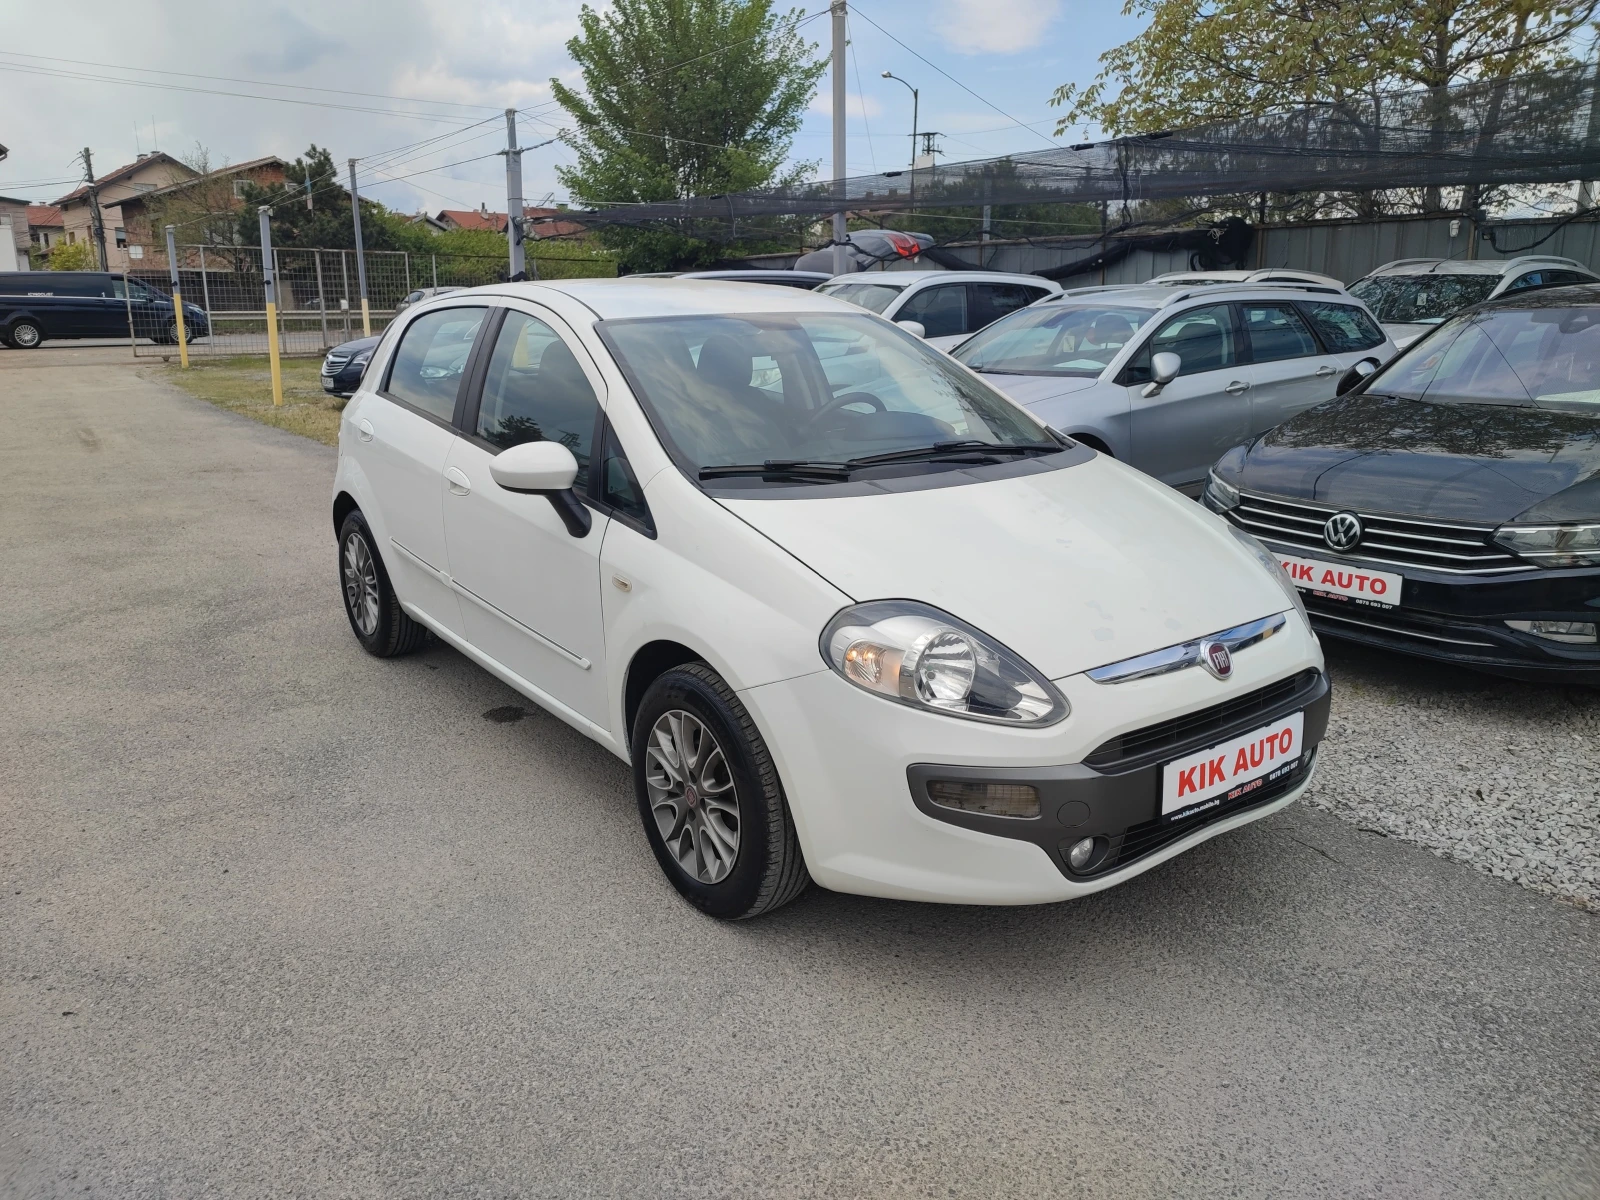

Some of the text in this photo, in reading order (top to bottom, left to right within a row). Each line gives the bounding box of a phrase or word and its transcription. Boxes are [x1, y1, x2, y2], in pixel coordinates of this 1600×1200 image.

[1321, 569, 1387, 595] AUTO
[1211, 650, 1230, 670] FIAT
[1177, 727, 1293, 798] KIK AUTO
[1227, 778, 1263, 800] KIK AUTO
